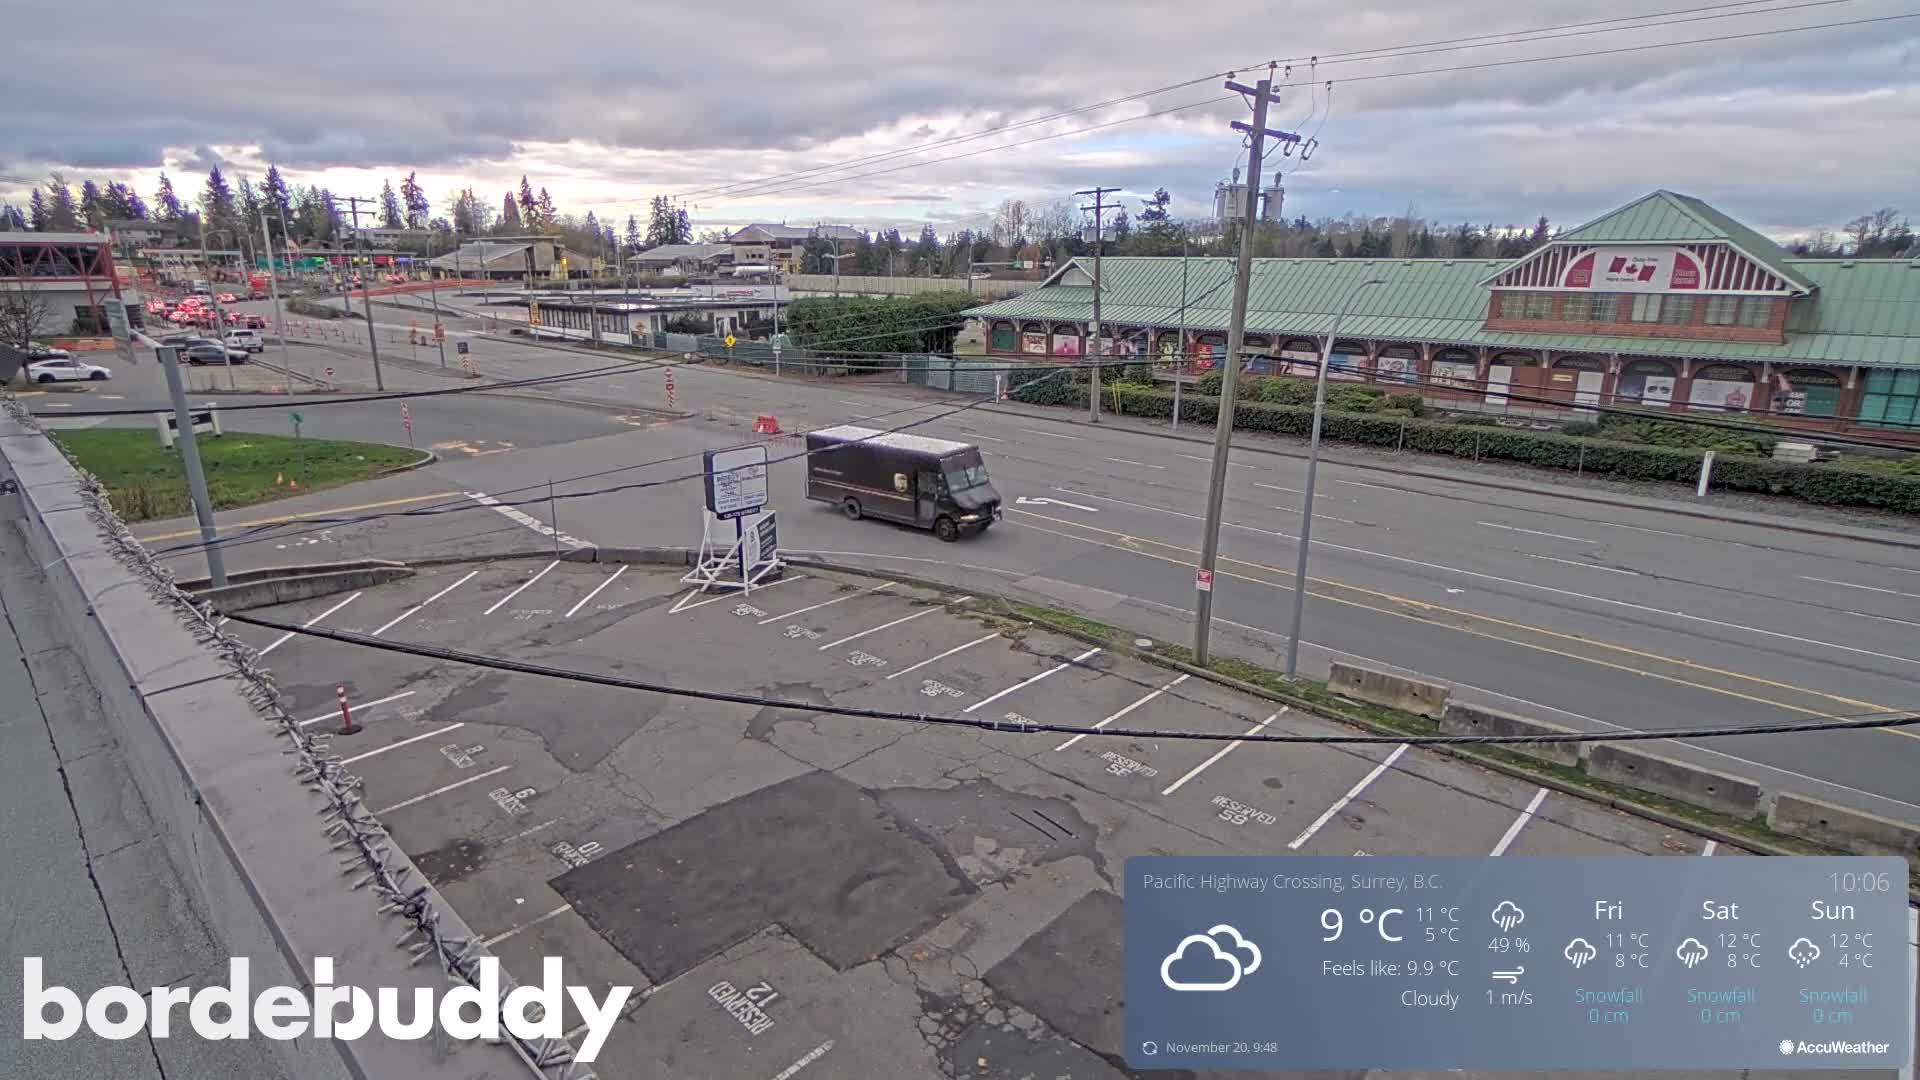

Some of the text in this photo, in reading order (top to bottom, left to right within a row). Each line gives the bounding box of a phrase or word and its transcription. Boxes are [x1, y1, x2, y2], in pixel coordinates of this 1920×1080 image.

[1210, 795, 1277, 825] RESERVED
[707, 980, 776, 1036] RESERVED
[746, 981, 779, 1007] 12
